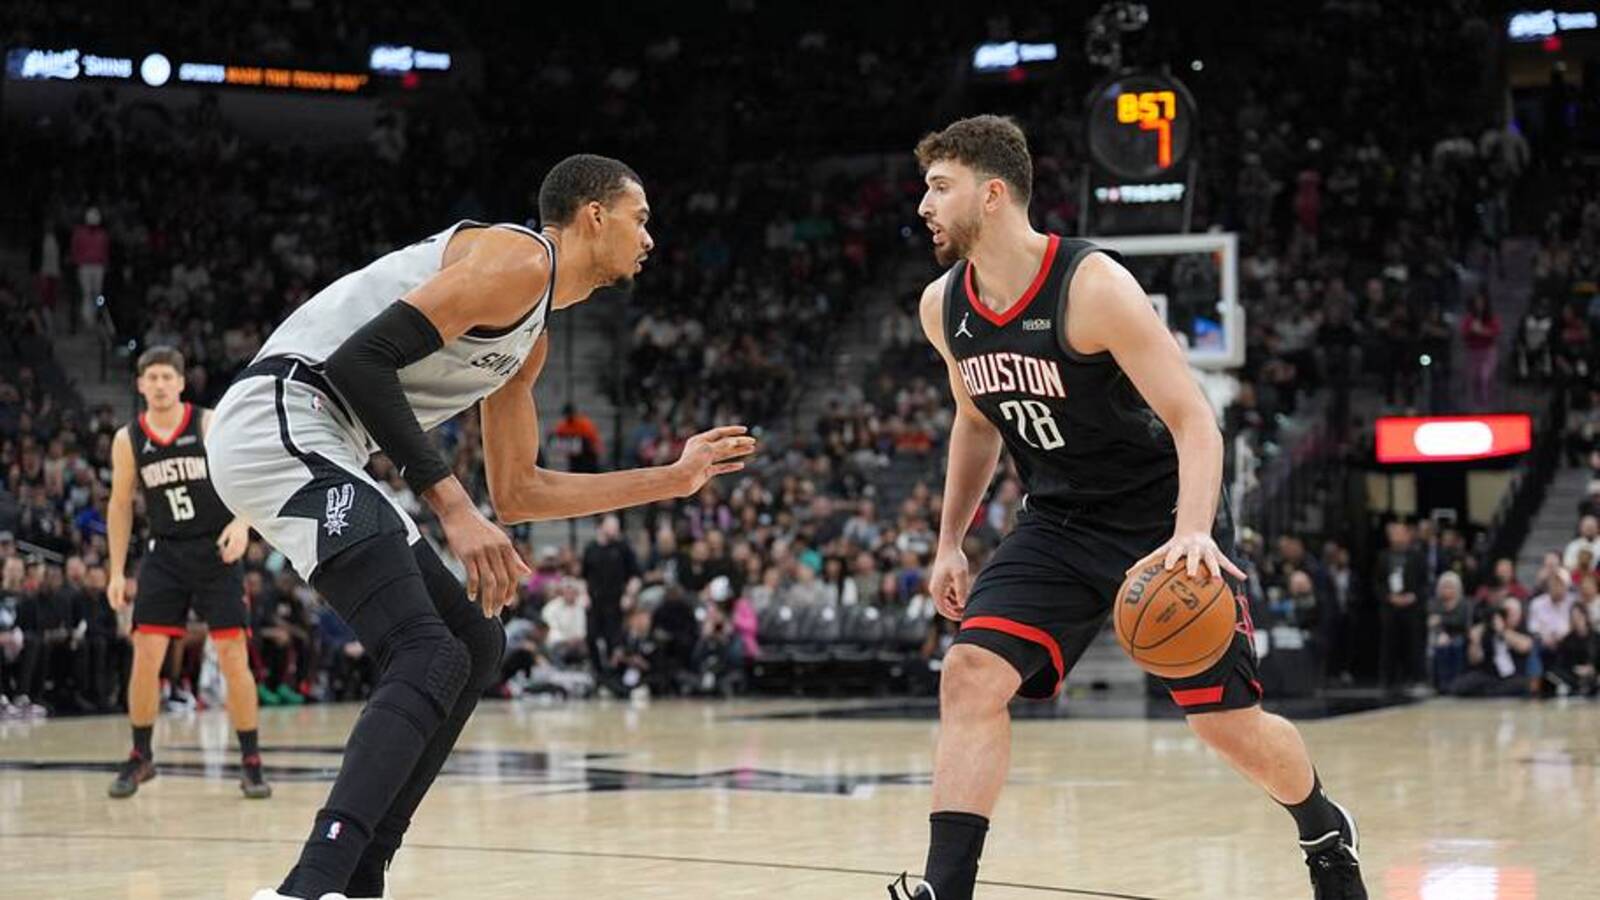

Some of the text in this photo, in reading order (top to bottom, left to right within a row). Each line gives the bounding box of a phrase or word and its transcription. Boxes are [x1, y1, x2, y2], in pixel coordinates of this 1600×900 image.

[957, 352, 1066, 398] HOUSTON
[141, 456, 207, 489] HOUSTON
[165, 485, 196, 521] 15
